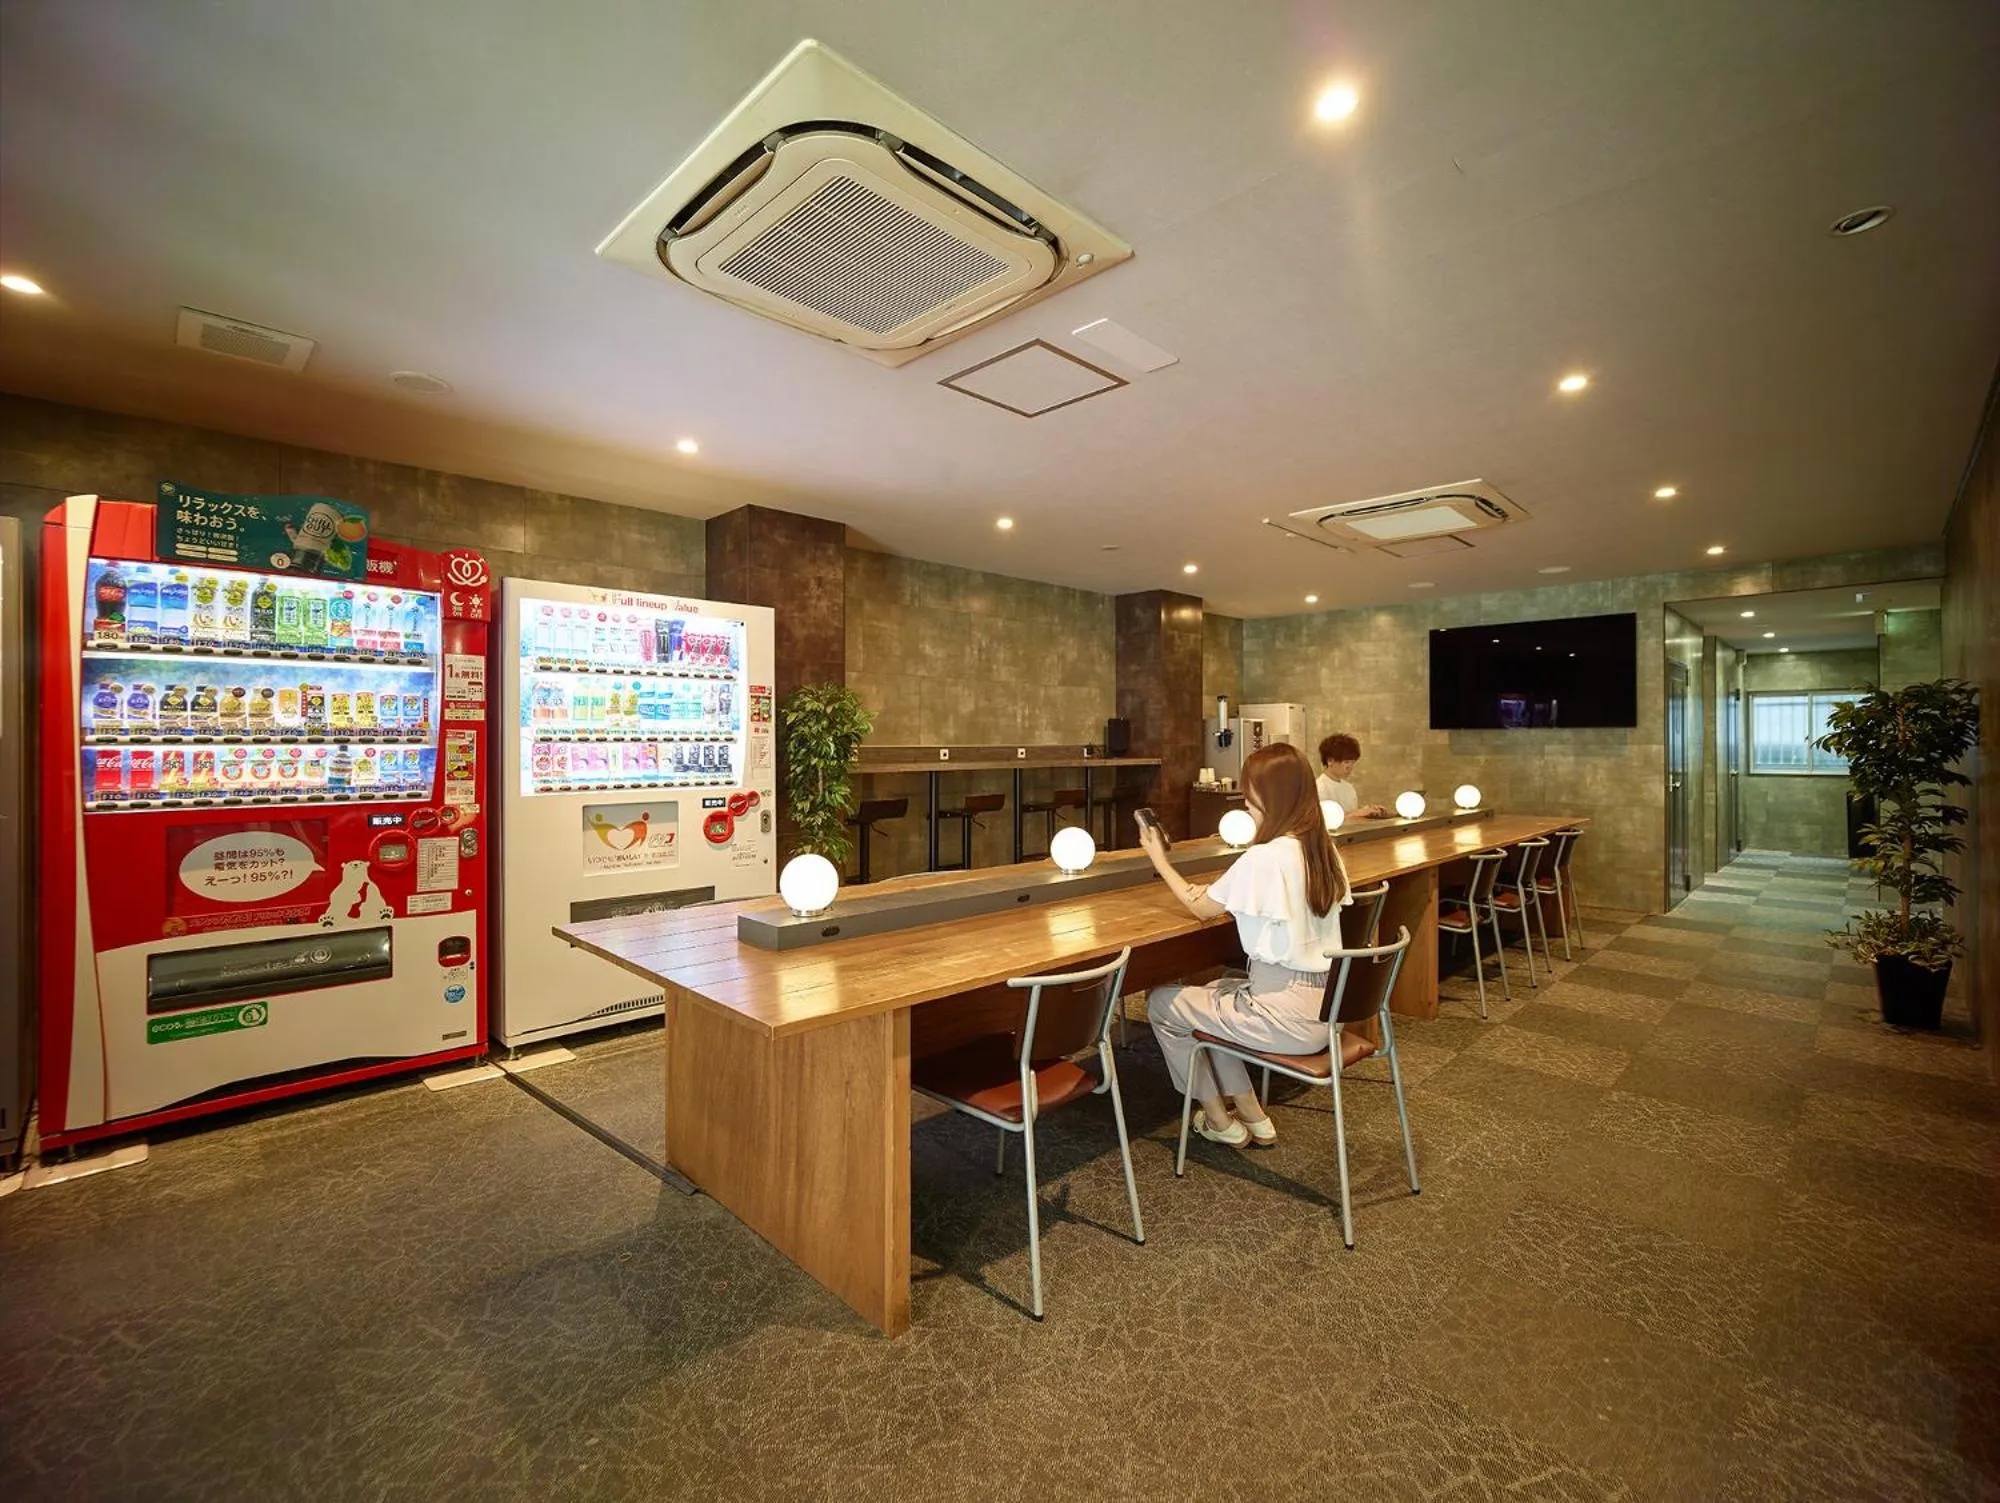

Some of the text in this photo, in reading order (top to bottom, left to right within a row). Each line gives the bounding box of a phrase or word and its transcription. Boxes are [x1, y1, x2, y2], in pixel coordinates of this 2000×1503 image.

[178, 494, 268, 521] リラックスを、
[175, 510, 246, 533] 味わおう。
[636, 598, 668, 611] lineup
[97, 631, 118, 640] 180
[372, 816, 402, 826] 販売中
[213, 858, 285, 872] 電気をカット?
